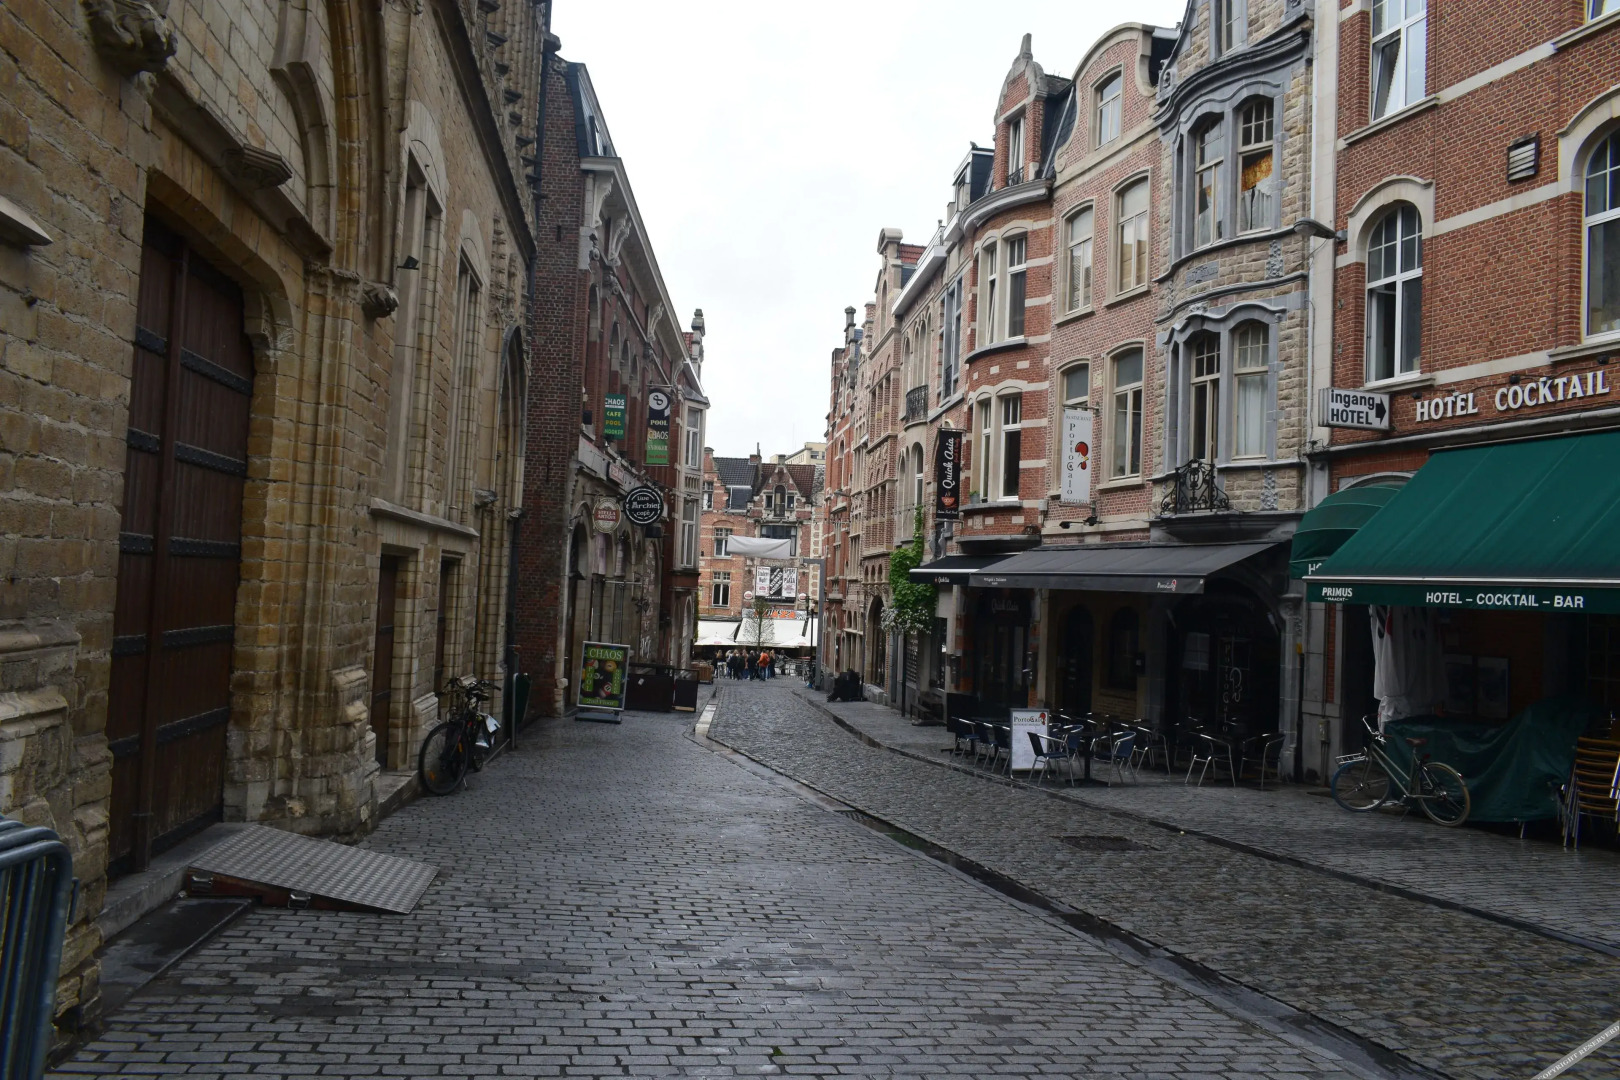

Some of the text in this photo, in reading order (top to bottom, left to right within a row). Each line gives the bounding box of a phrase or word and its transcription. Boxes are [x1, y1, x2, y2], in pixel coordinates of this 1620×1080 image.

[1330, 390, 1375, 410] ingang
[1415, 370, 1610, 422] HOTEL COCKTAIL
[1330, 408, 1373, 425] HOTEL
[942, 437, 956, 489] Quick Asia
[1321, 587, 1353, 597] PRIMUS
[1426, 592, 1463, 604] HOTEL
[1476, 593, 1539, 607] COCKTAIL
[1553, 595, 1584, 608] BAR
[589, 648, 623, 660] CHAOS
